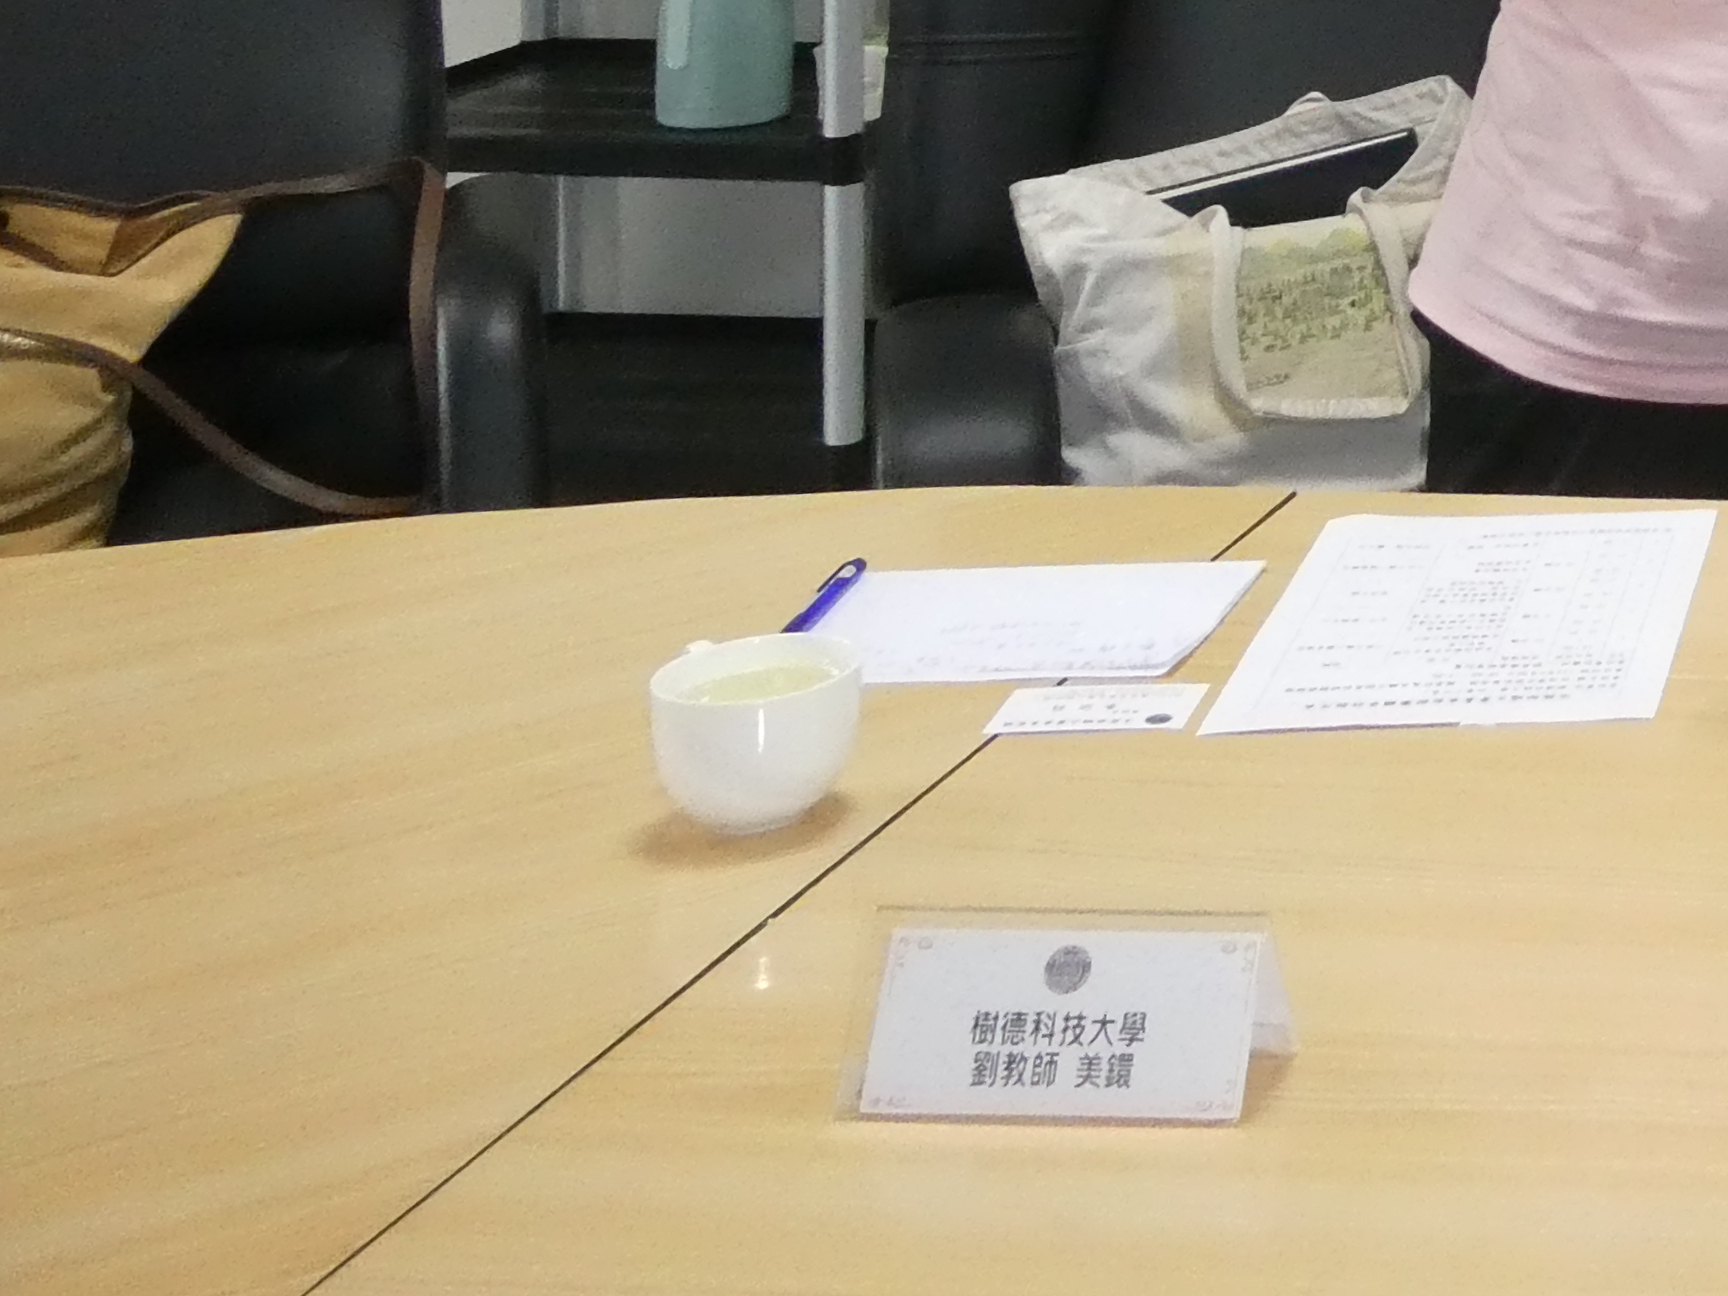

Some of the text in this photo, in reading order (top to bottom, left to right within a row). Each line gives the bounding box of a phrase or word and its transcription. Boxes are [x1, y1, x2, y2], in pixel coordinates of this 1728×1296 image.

[970, 1009, 1147, 1048] 樹德科技大學
[969, 1051, 1060, 1089] 劉教師
